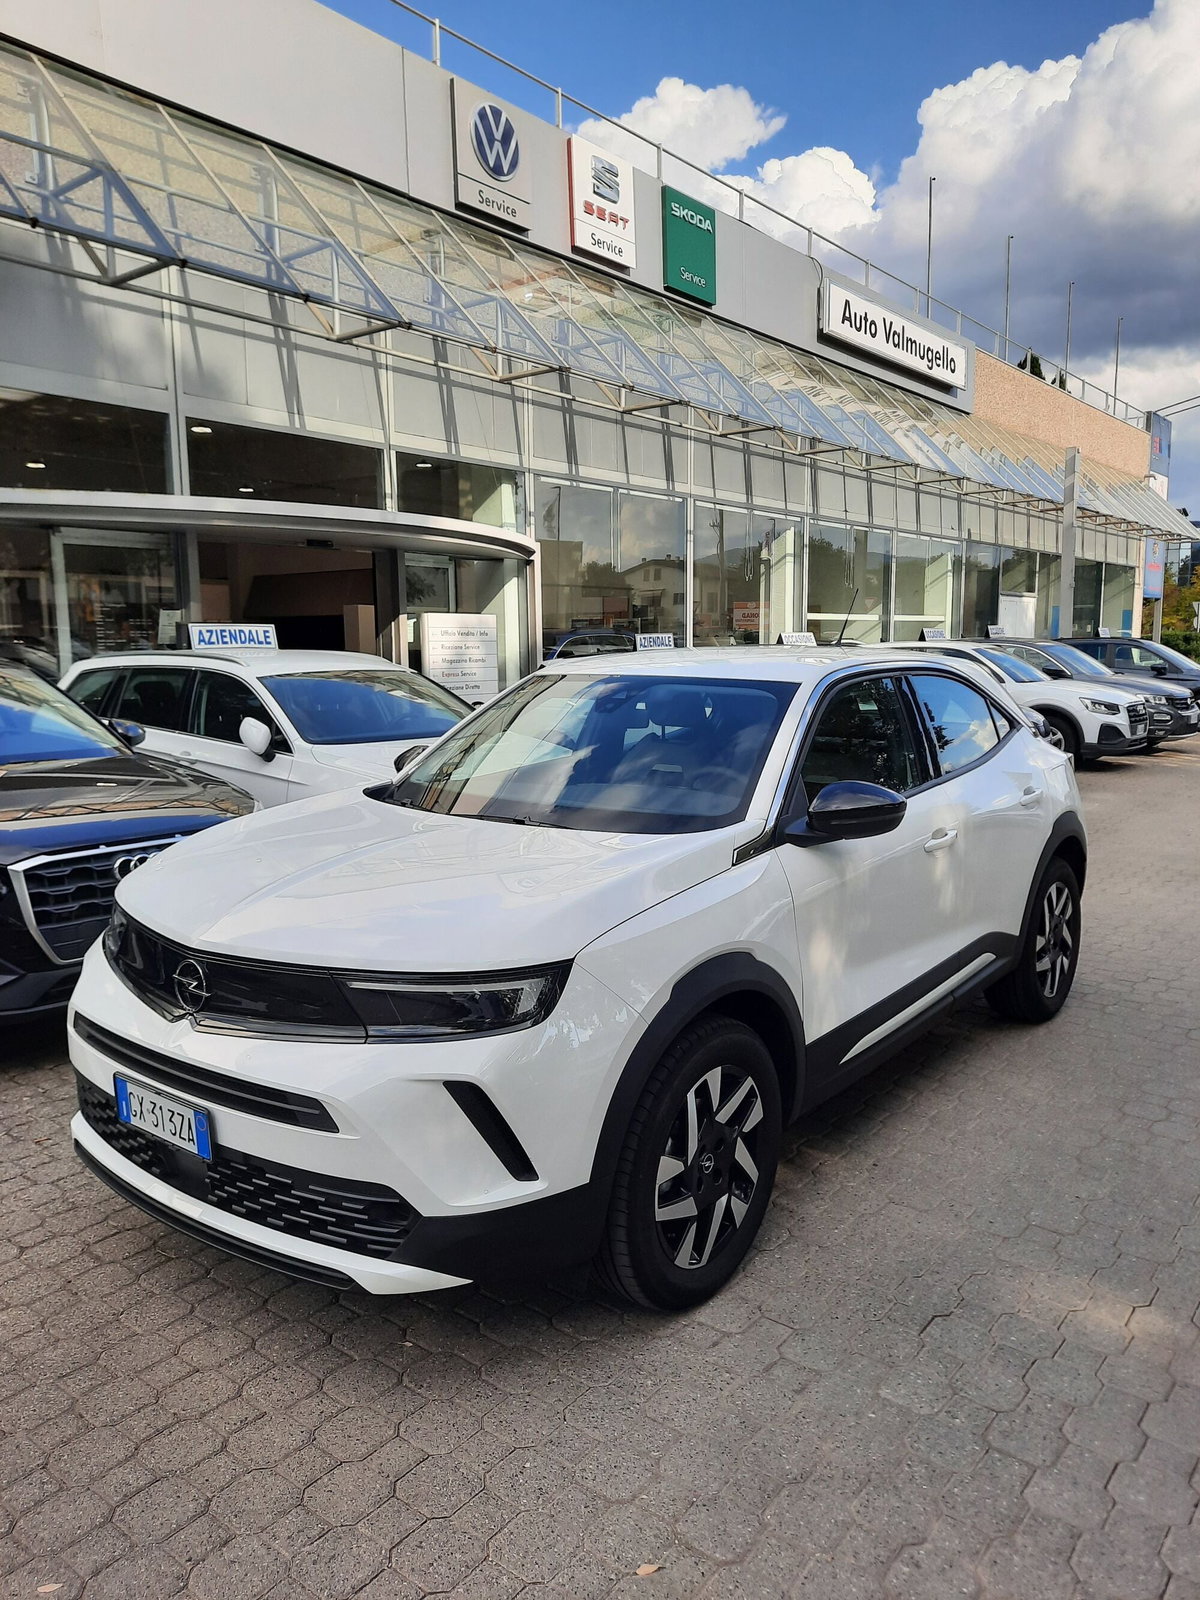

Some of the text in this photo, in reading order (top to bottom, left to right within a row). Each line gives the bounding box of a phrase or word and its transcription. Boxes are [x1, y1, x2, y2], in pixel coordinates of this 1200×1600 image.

[478, 189, 517, 218] Service
[583, 199, 630, 231] SEAT
[590, 232, 623, 257] Service
[680, 266, 706, 287] Service
[841, 298, 956, 374] Auto Valmugello
[198, 629, 272, 646] AZIENDALE
[639, 635, 672, 648] AZIENDALE
